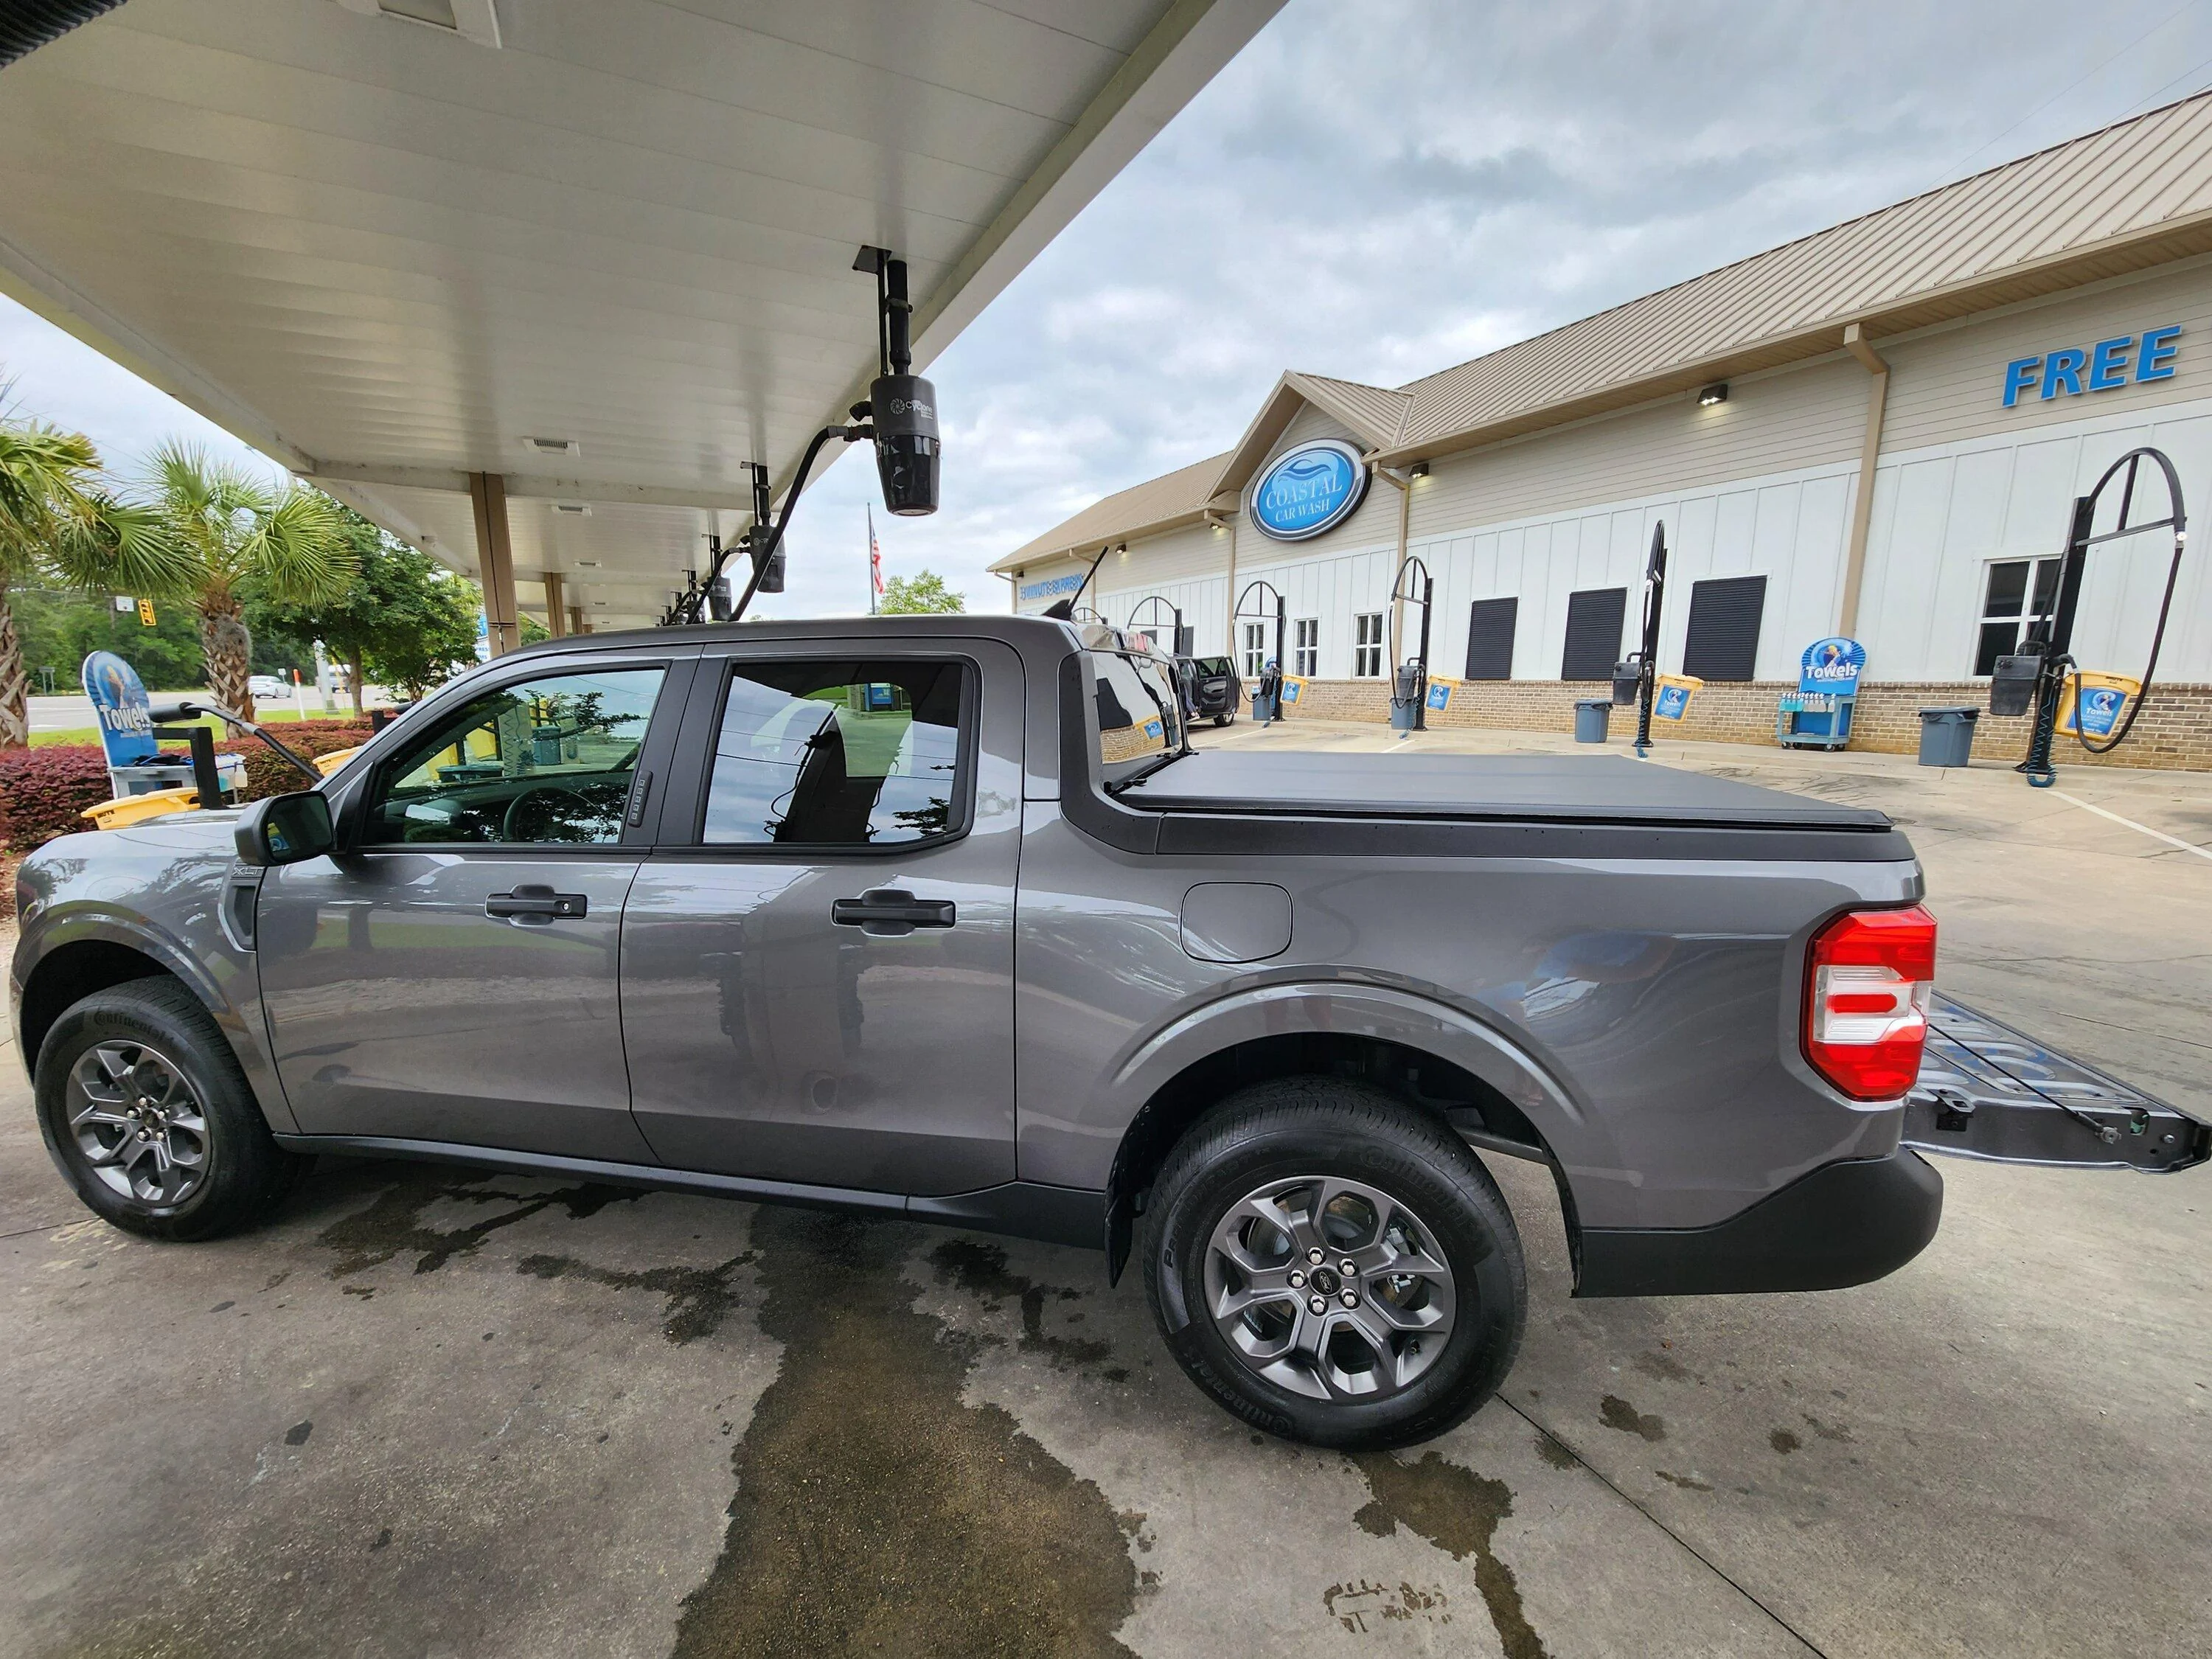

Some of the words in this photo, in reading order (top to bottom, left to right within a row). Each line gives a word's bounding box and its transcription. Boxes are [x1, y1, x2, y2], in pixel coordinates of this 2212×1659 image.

[2003, 324, 2183, 408] FREE
[1266, 473, 1342, 509] COASTAL
[1276, 508, 1295, 523] CAR
[1298, 498, 1330, 516] WASH
[1806, 662, 1858, 679] Towels
[98, 702, 151, 731] Towels
[232, 866, 265, 875] XLT
